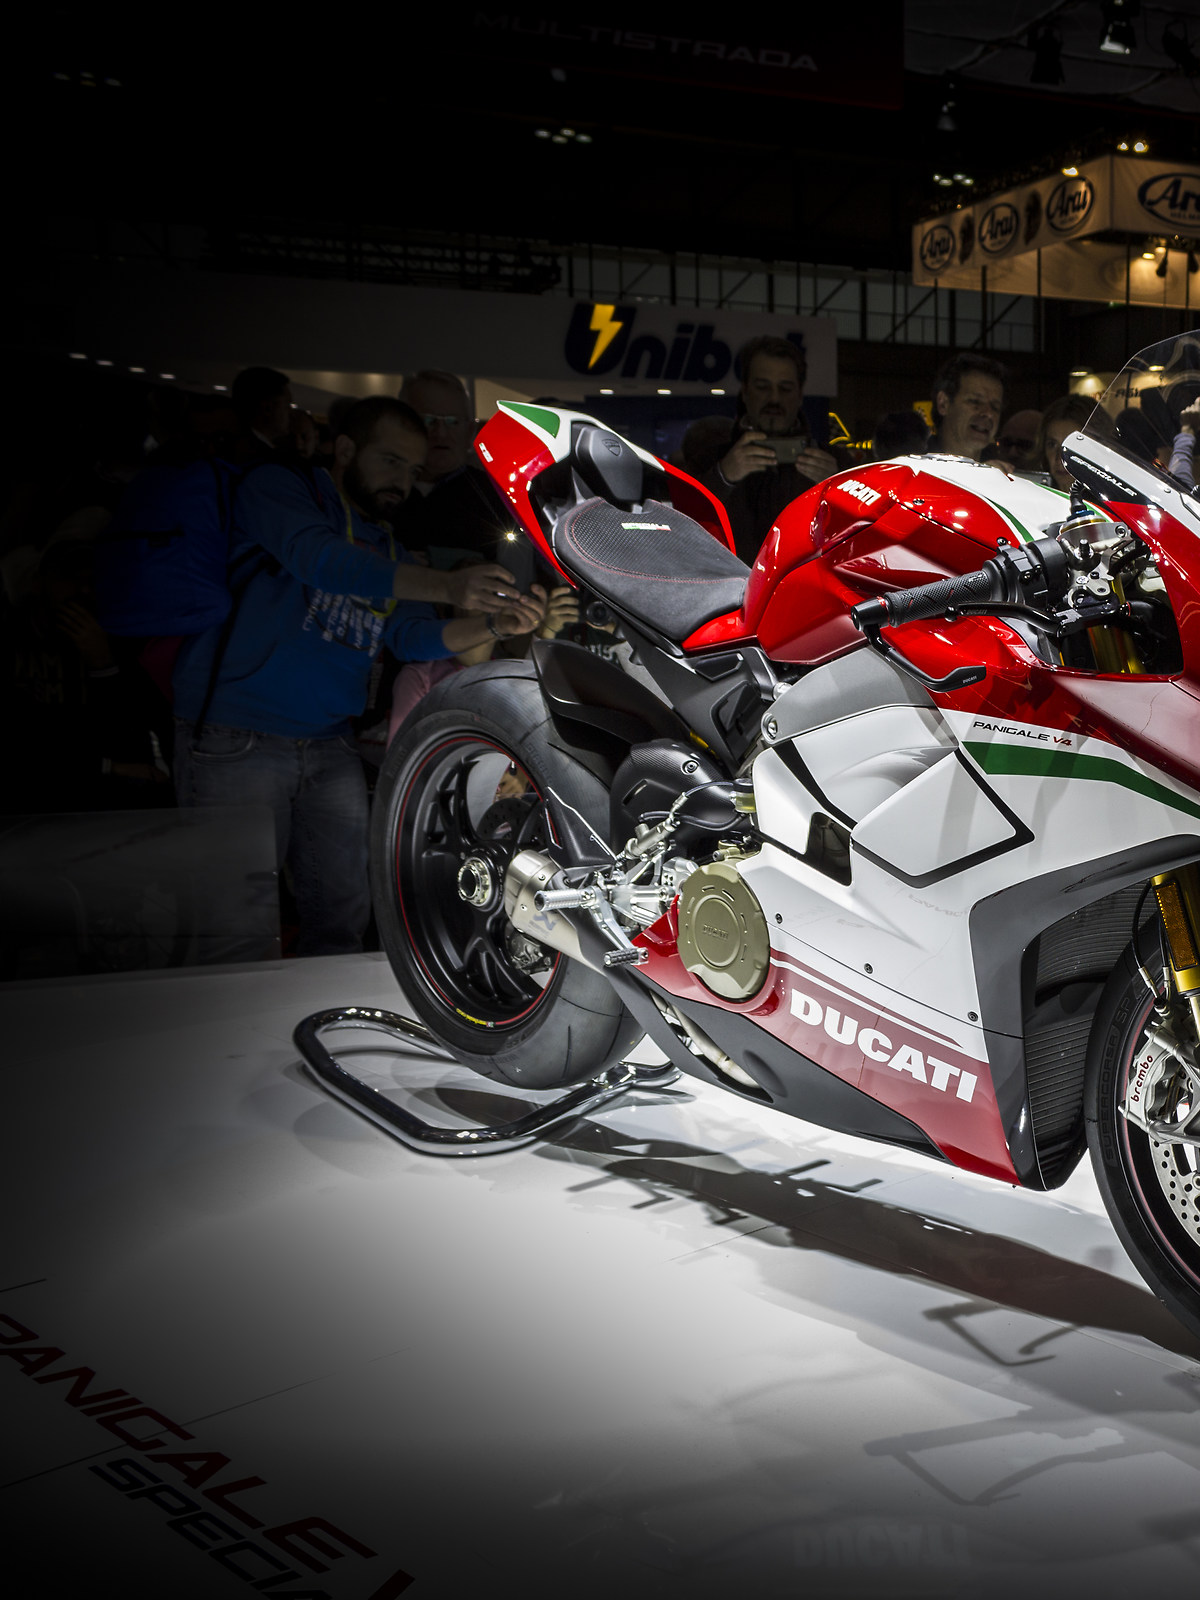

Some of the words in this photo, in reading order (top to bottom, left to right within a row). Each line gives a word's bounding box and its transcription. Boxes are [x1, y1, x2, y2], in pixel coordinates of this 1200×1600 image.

[471, 10, 819, 72] MULTISTRADA
[1048, 186, 1087, 219] Arai
[980, 208, 1014, 241] Arai
[836, 479, 881, 506] DUCATI
[973, 721, 1051, 742] PANIGALE
[1053, 736, 1072, 747] V4
[790, 989, 978, 1103] DUCATI
[1101, 1033, 1118, 1162] SUPERCORSA
[1131, 1055, 1153, 1102] brembo
